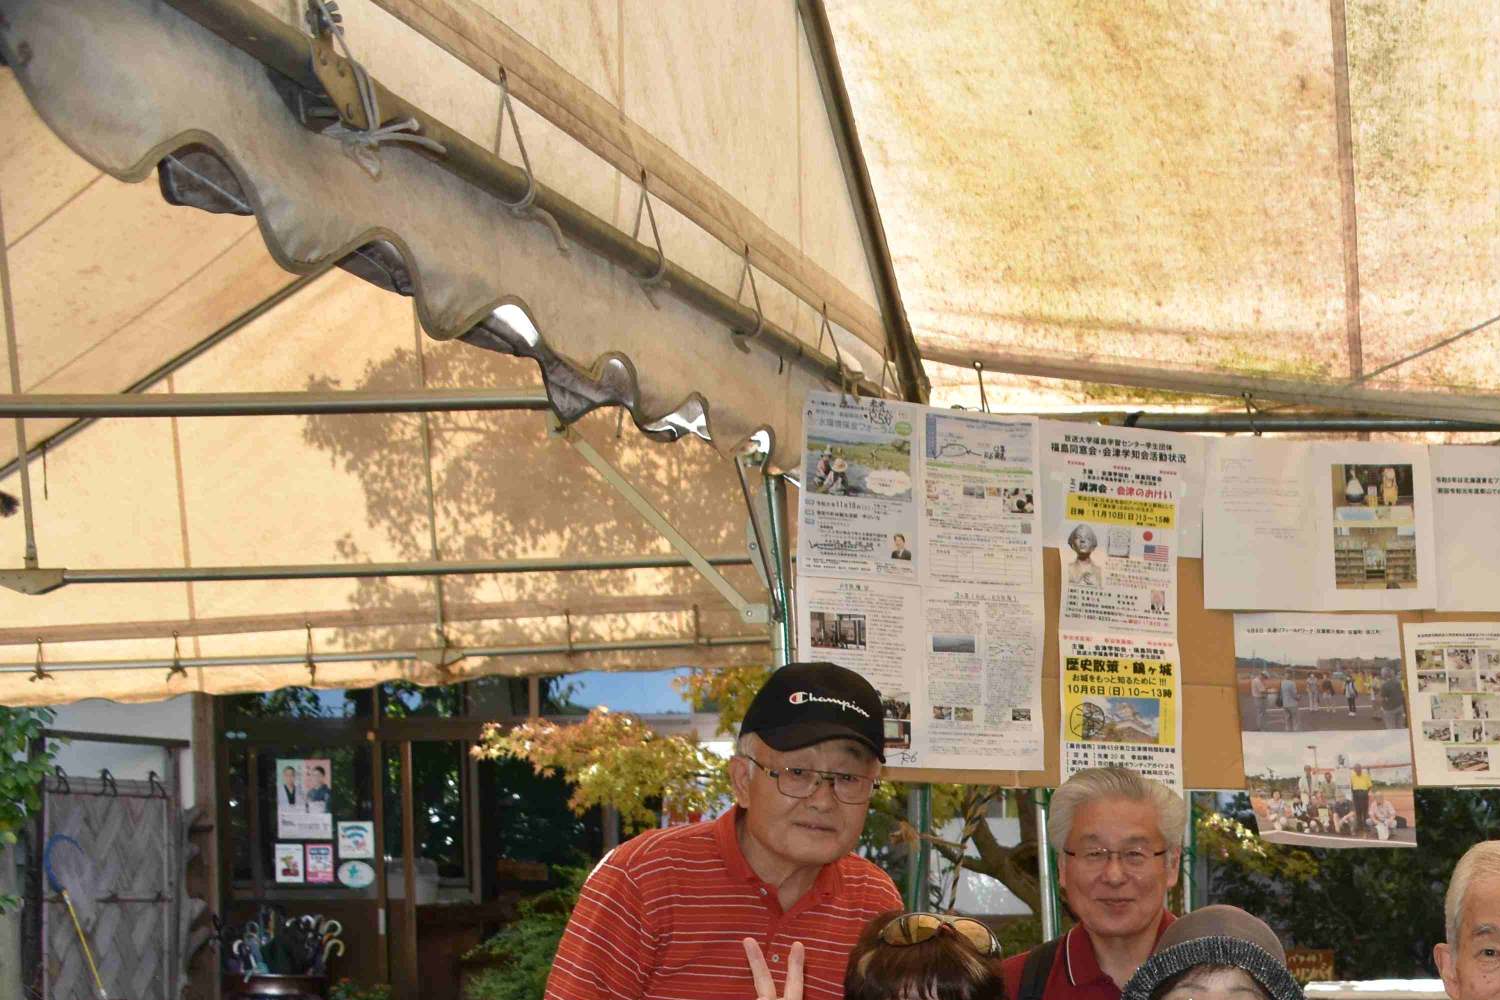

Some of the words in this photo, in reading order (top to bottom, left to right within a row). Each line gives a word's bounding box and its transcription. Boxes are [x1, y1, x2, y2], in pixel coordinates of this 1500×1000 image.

[1064, 434, 1172, 451] 放送大学福島学習センター学生団体
[1051, 442, 1187, 464] 福島同窓会・会津学知会活動状況
[1066, 657, 1172, 677] 歴史散策・鶴ヶ城
[1072, 674, 1157, 686] お城をもっと知るために
[789, 691, 870, 718] Champion
